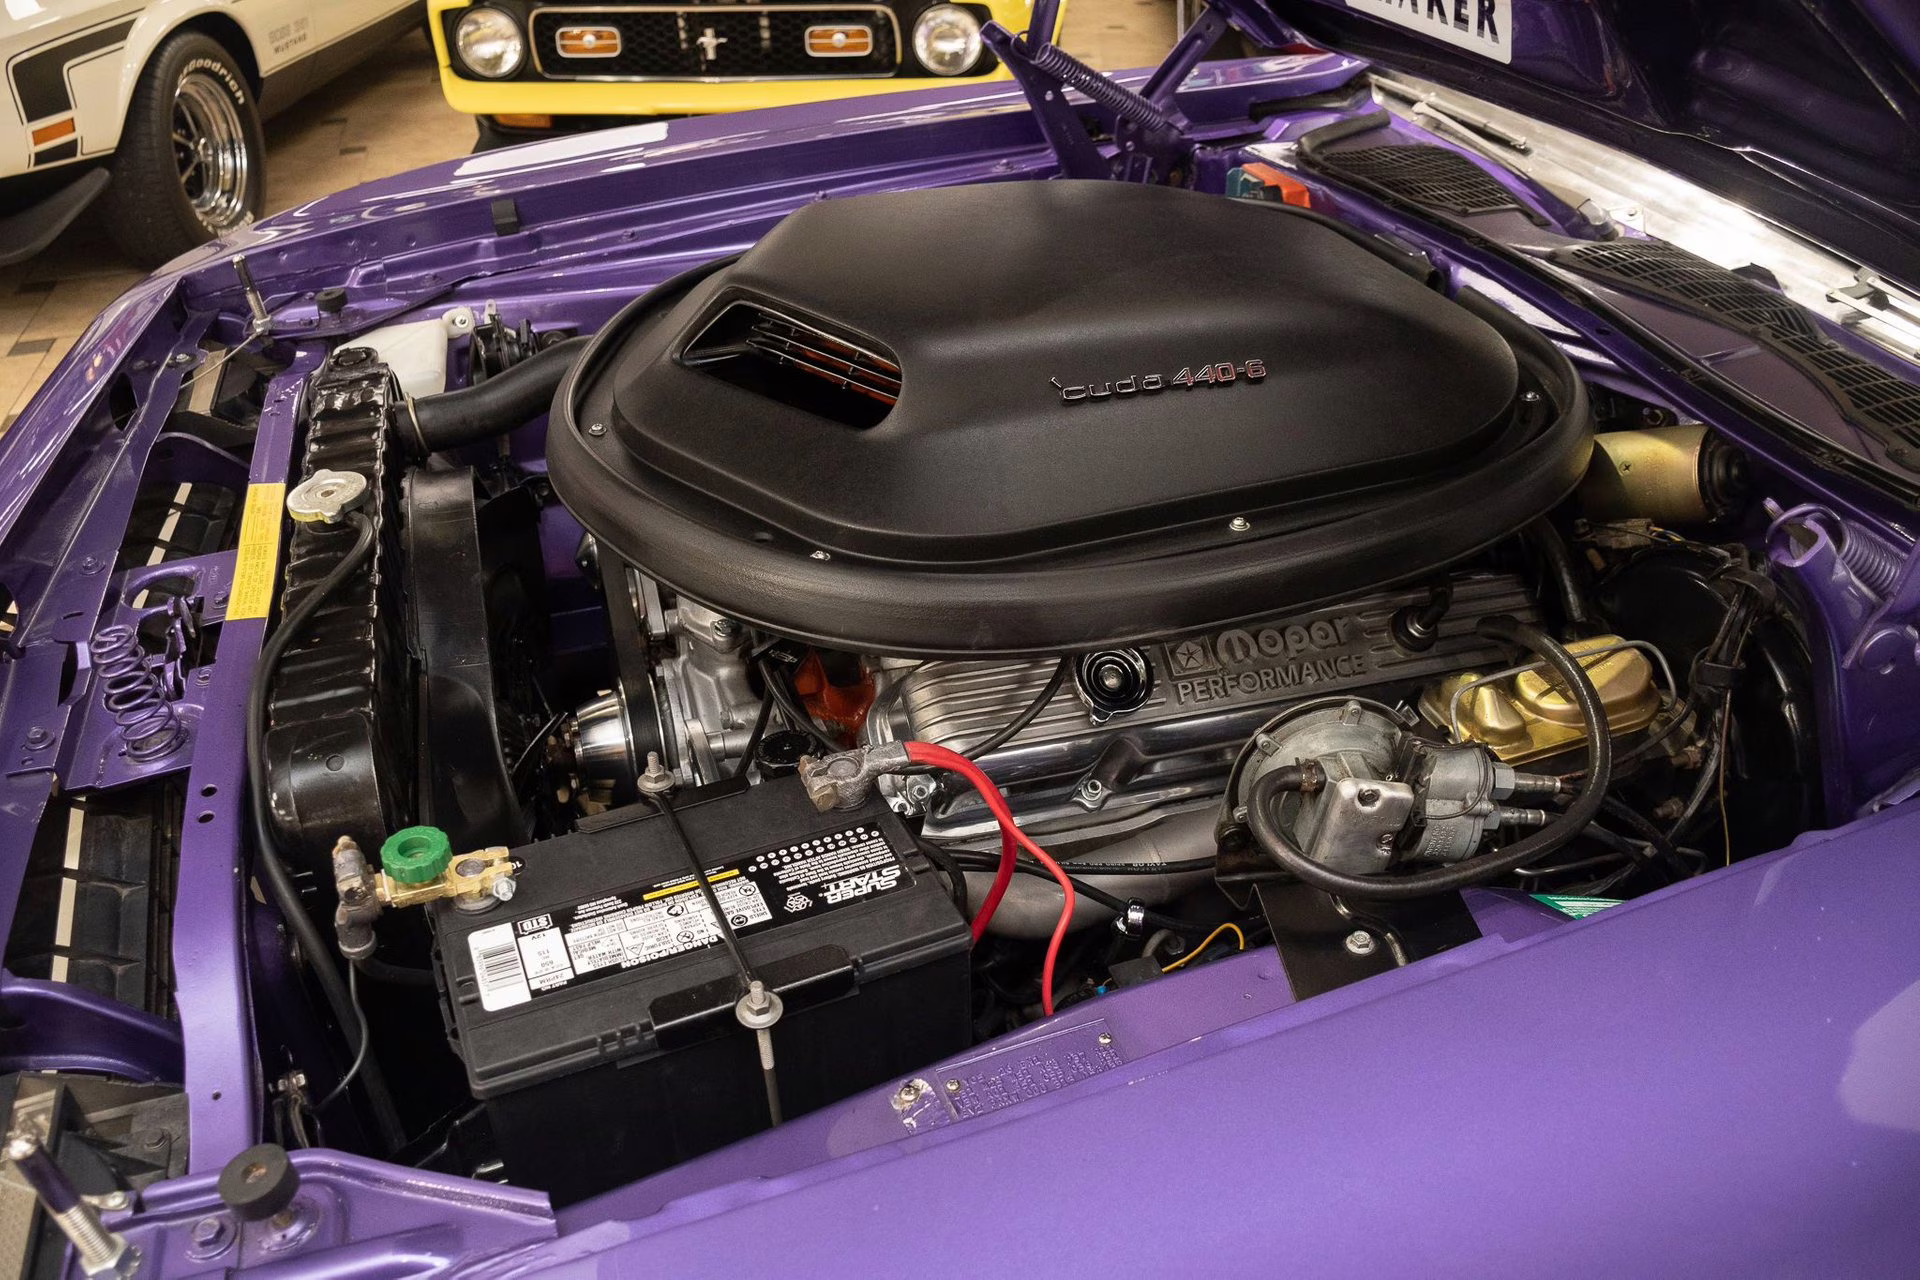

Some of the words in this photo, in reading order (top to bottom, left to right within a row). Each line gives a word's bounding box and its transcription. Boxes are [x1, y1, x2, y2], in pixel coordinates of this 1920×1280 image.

[1171, 359, 1267, 387] 440-6
[1216, 616, 1351, 664] Mopar
[1177, 654, 1368, 705] PERFORMANCE
[823, 865, 901, 893] START
[827, 879, 897, 904] SUPER
[620, 934, 717, 968] DANGER/POISON
